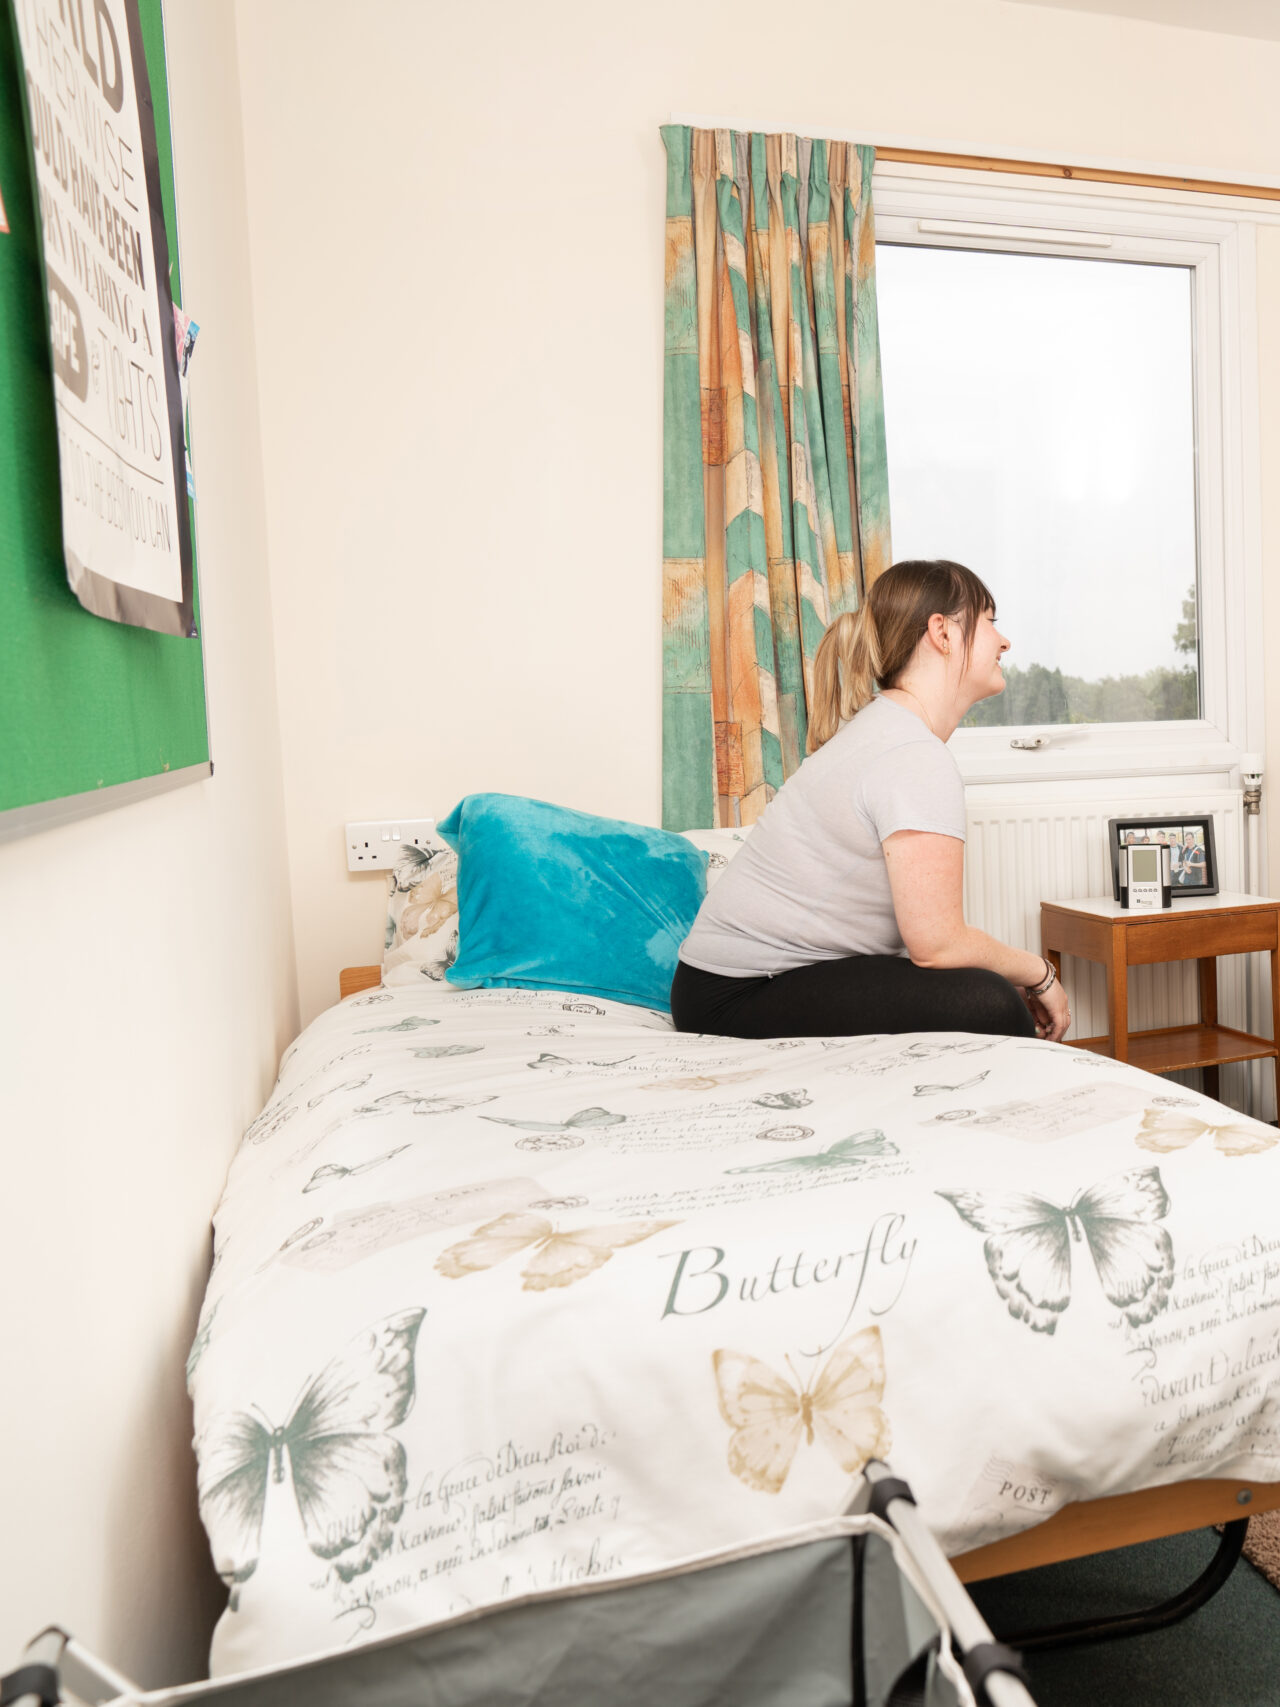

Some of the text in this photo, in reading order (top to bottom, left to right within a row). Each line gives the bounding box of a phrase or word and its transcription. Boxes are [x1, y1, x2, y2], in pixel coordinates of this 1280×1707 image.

[68, 136, 104, 248] HAVE
[104, 192, 146, 291] BEEN
[68, 219, 137, 343] WEARING
[142, 308, 154, 357] A
[98, 327, 162, 461] TIGHTS
[147, 495, 172, 553] CAN
[657, 1212, 918, 1357] Butterfly
[998, 1480, 1054, 1505] POST
